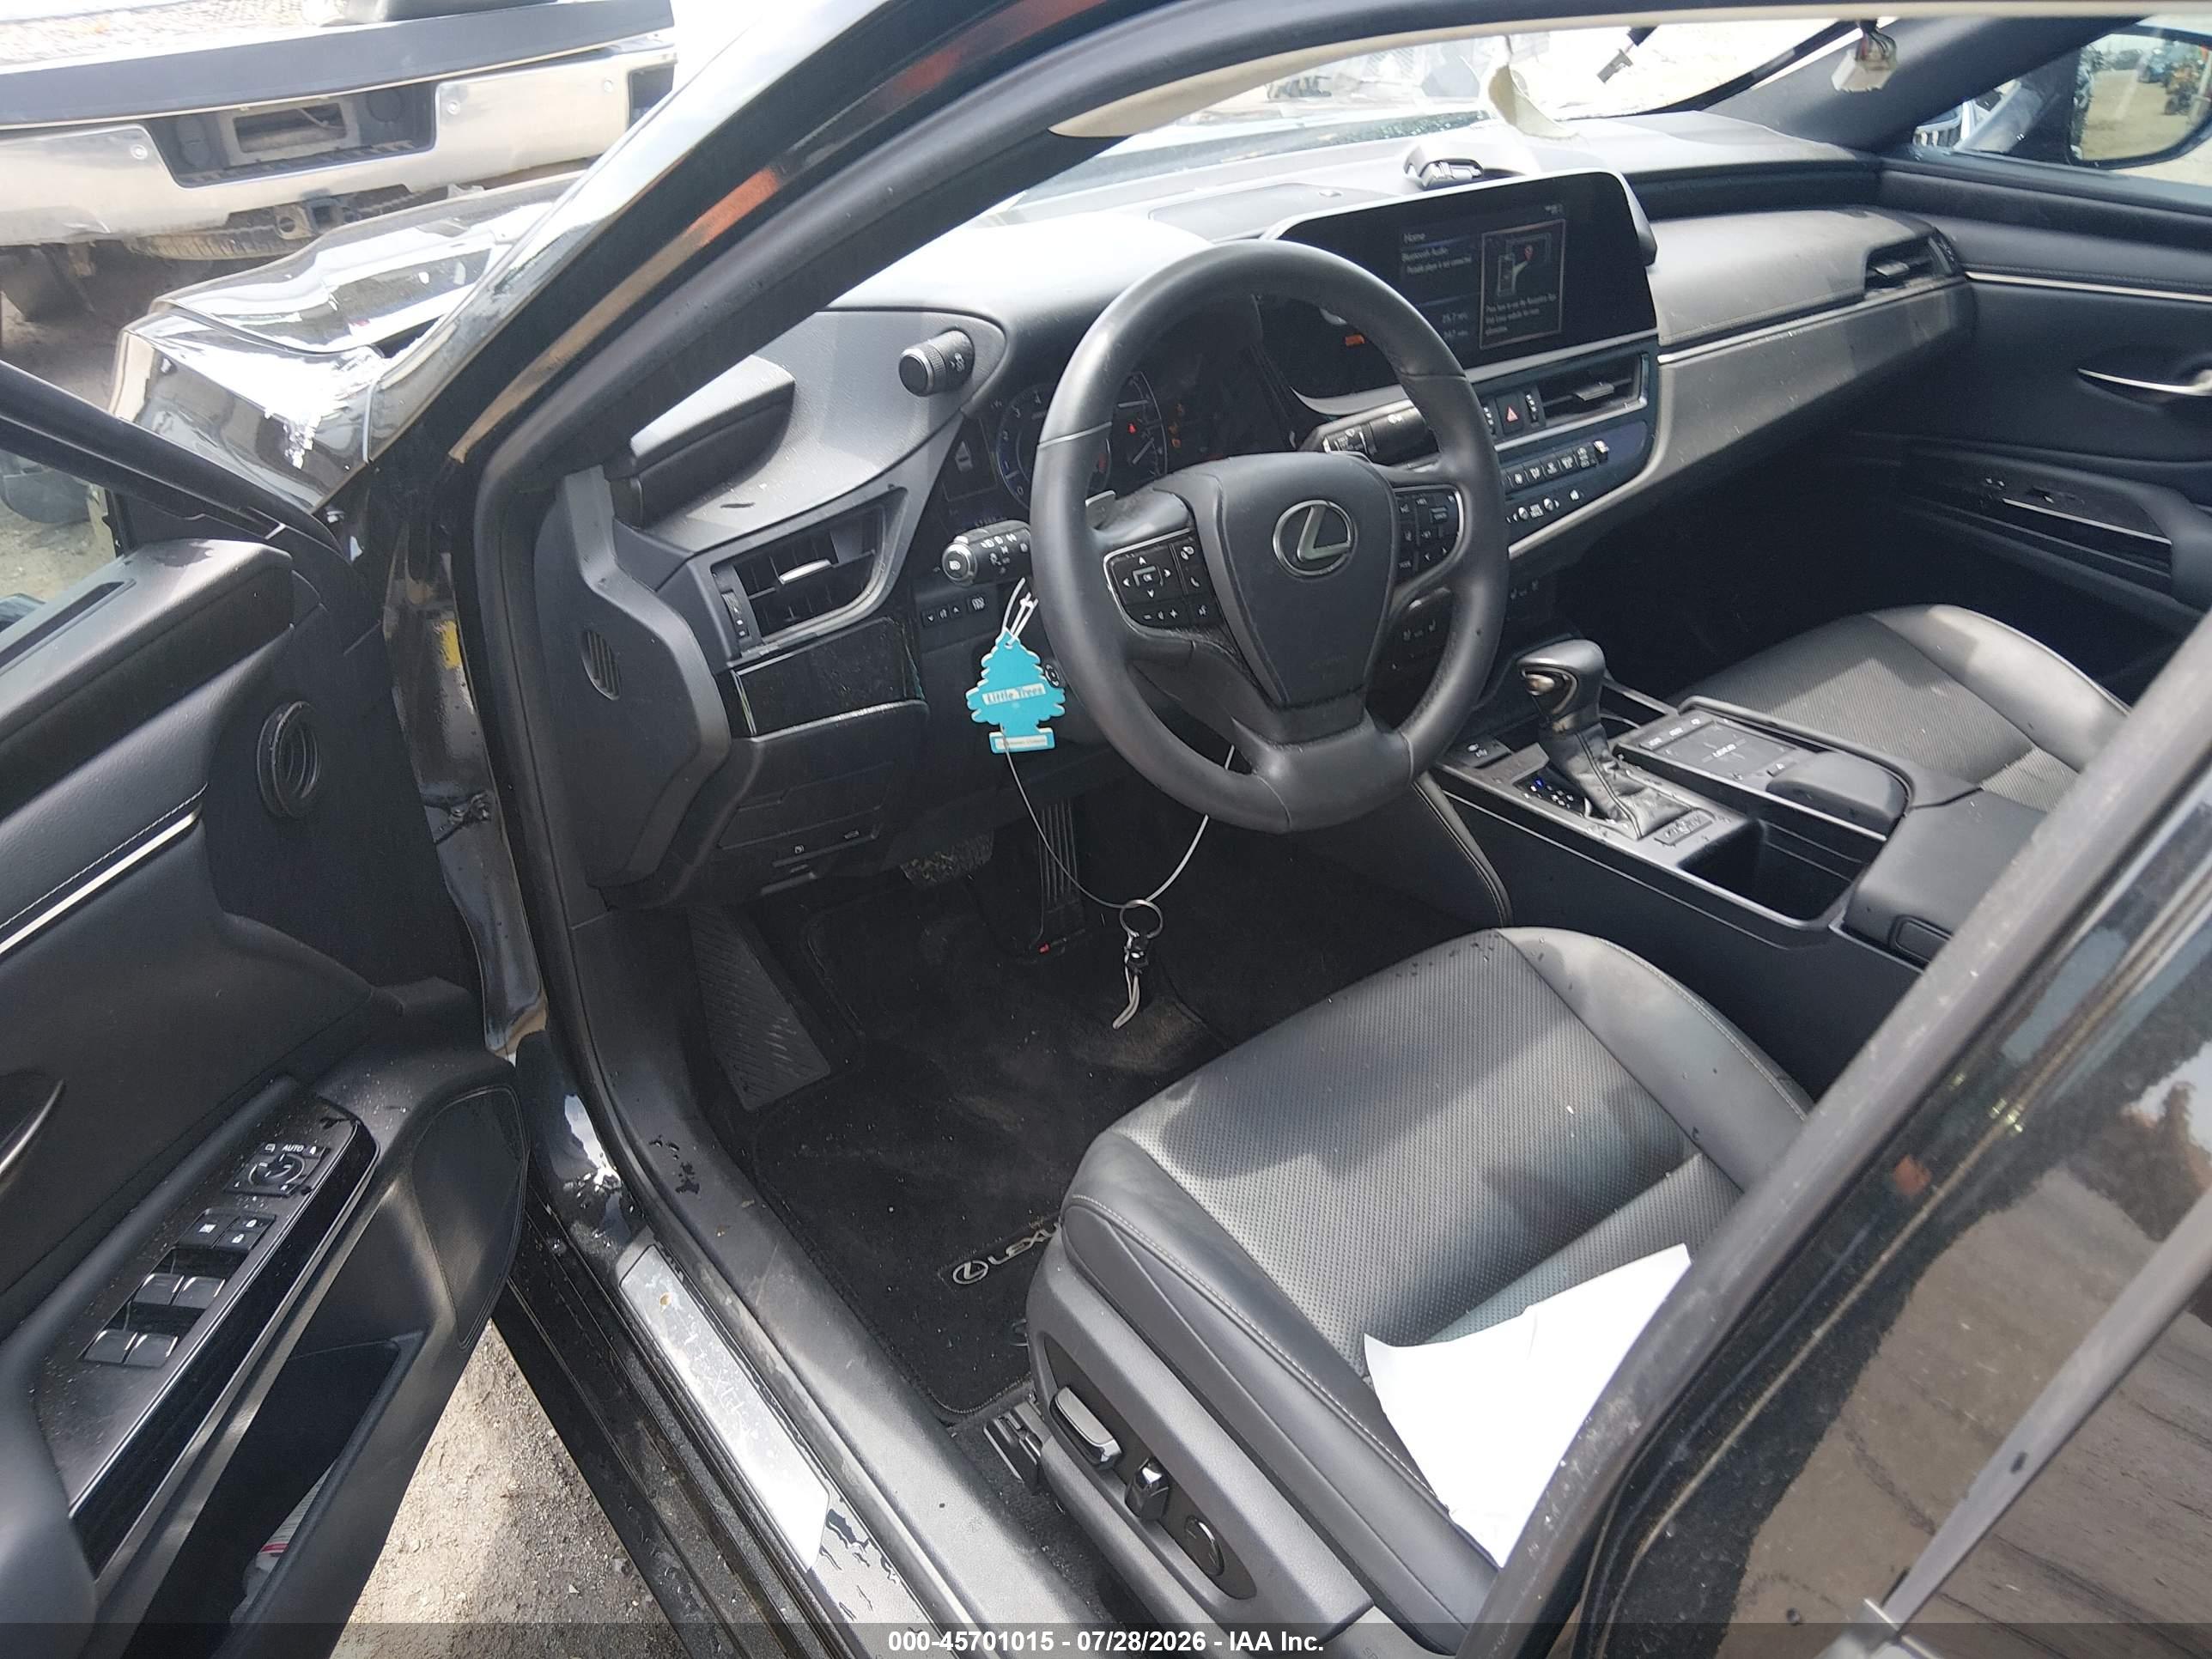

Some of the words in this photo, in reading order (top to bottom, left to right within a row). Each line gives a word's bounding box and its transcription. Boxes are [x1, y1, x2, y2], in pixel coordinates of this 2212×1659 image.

[987, 690, 1015, 704] Little
[1015, 685, 1043, 699] Trees
[282, 1144, 304, 1152] AUTO
